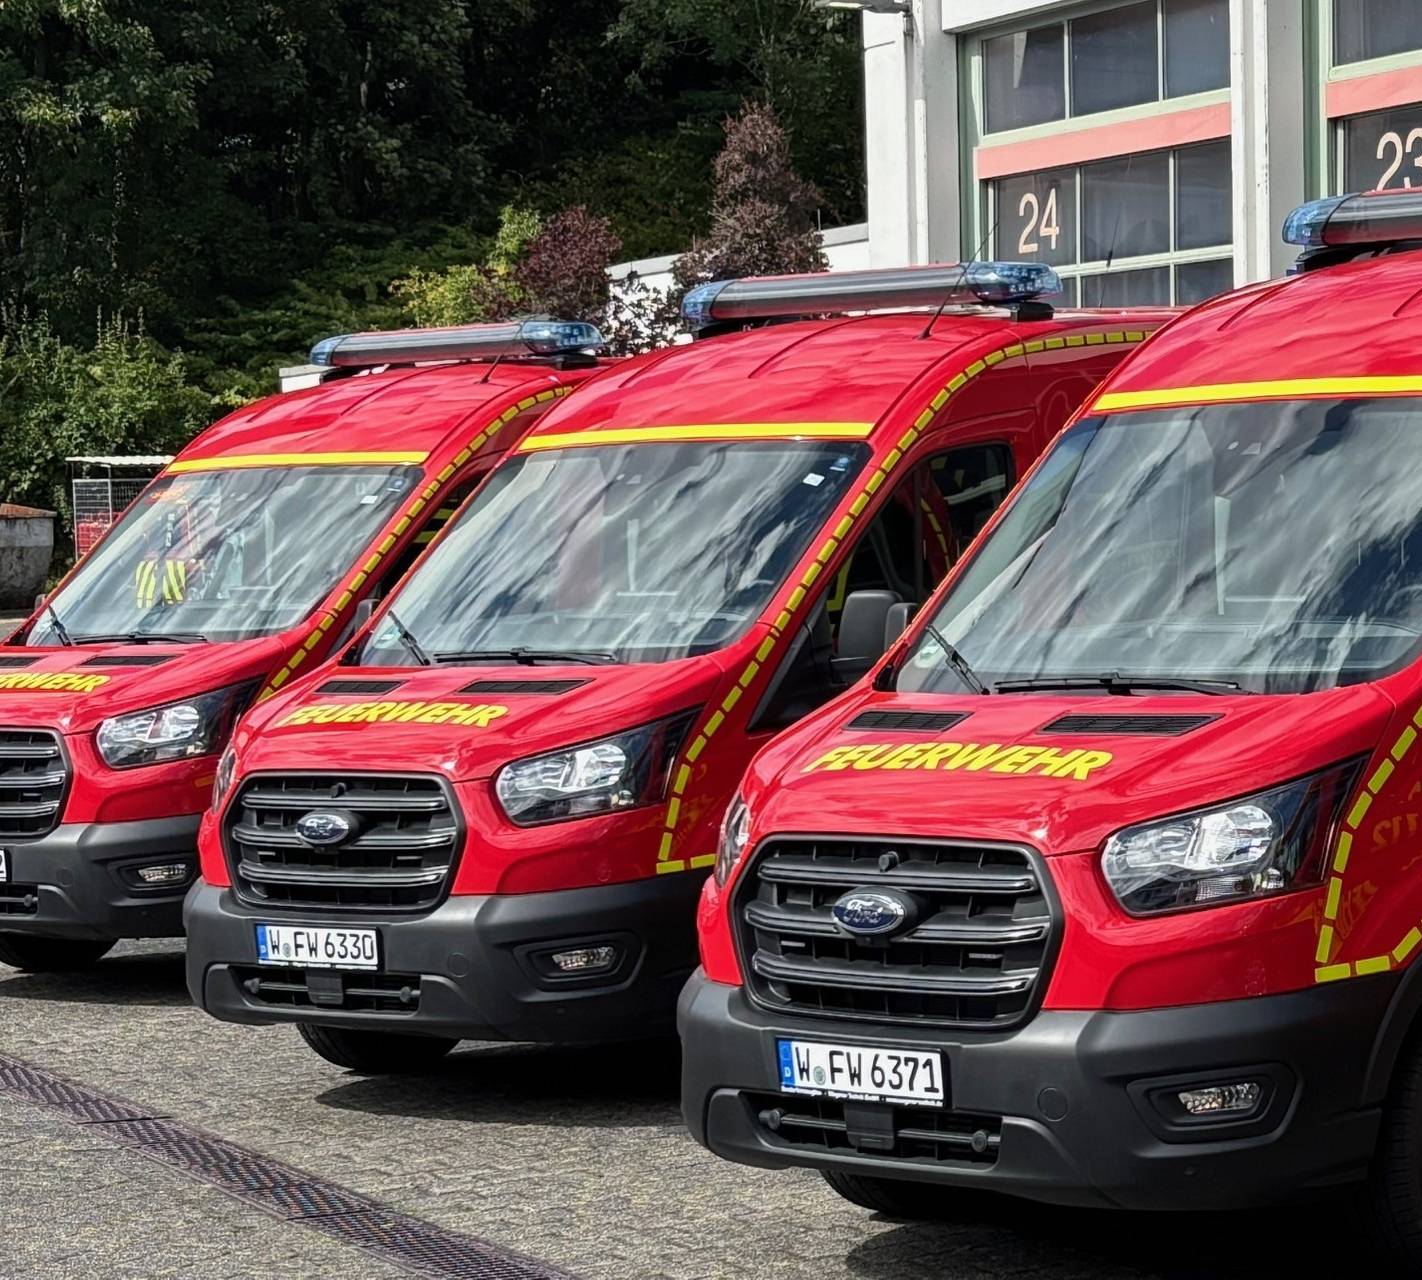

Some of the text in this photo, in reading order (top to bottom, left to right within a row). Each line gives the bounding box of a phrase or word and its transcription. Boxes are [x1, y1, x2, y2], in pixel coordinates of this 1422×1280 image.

[1018, 188, 1060, 254] 24
[274, 702, 509, 727] FEUERWEHR
[800, 742, 1113, 780] FEUERWEHR
[843, 899, 884, 924] Ford
[268, 929, 281, 955] W
[293, 931, 319, 958] FW
[324, 932, 375, 960] 6330
[795, 1047, 811, 1083] W
[829, 1050, 862, 1087] FW
[870, 1053, 940, 1094] 6371
